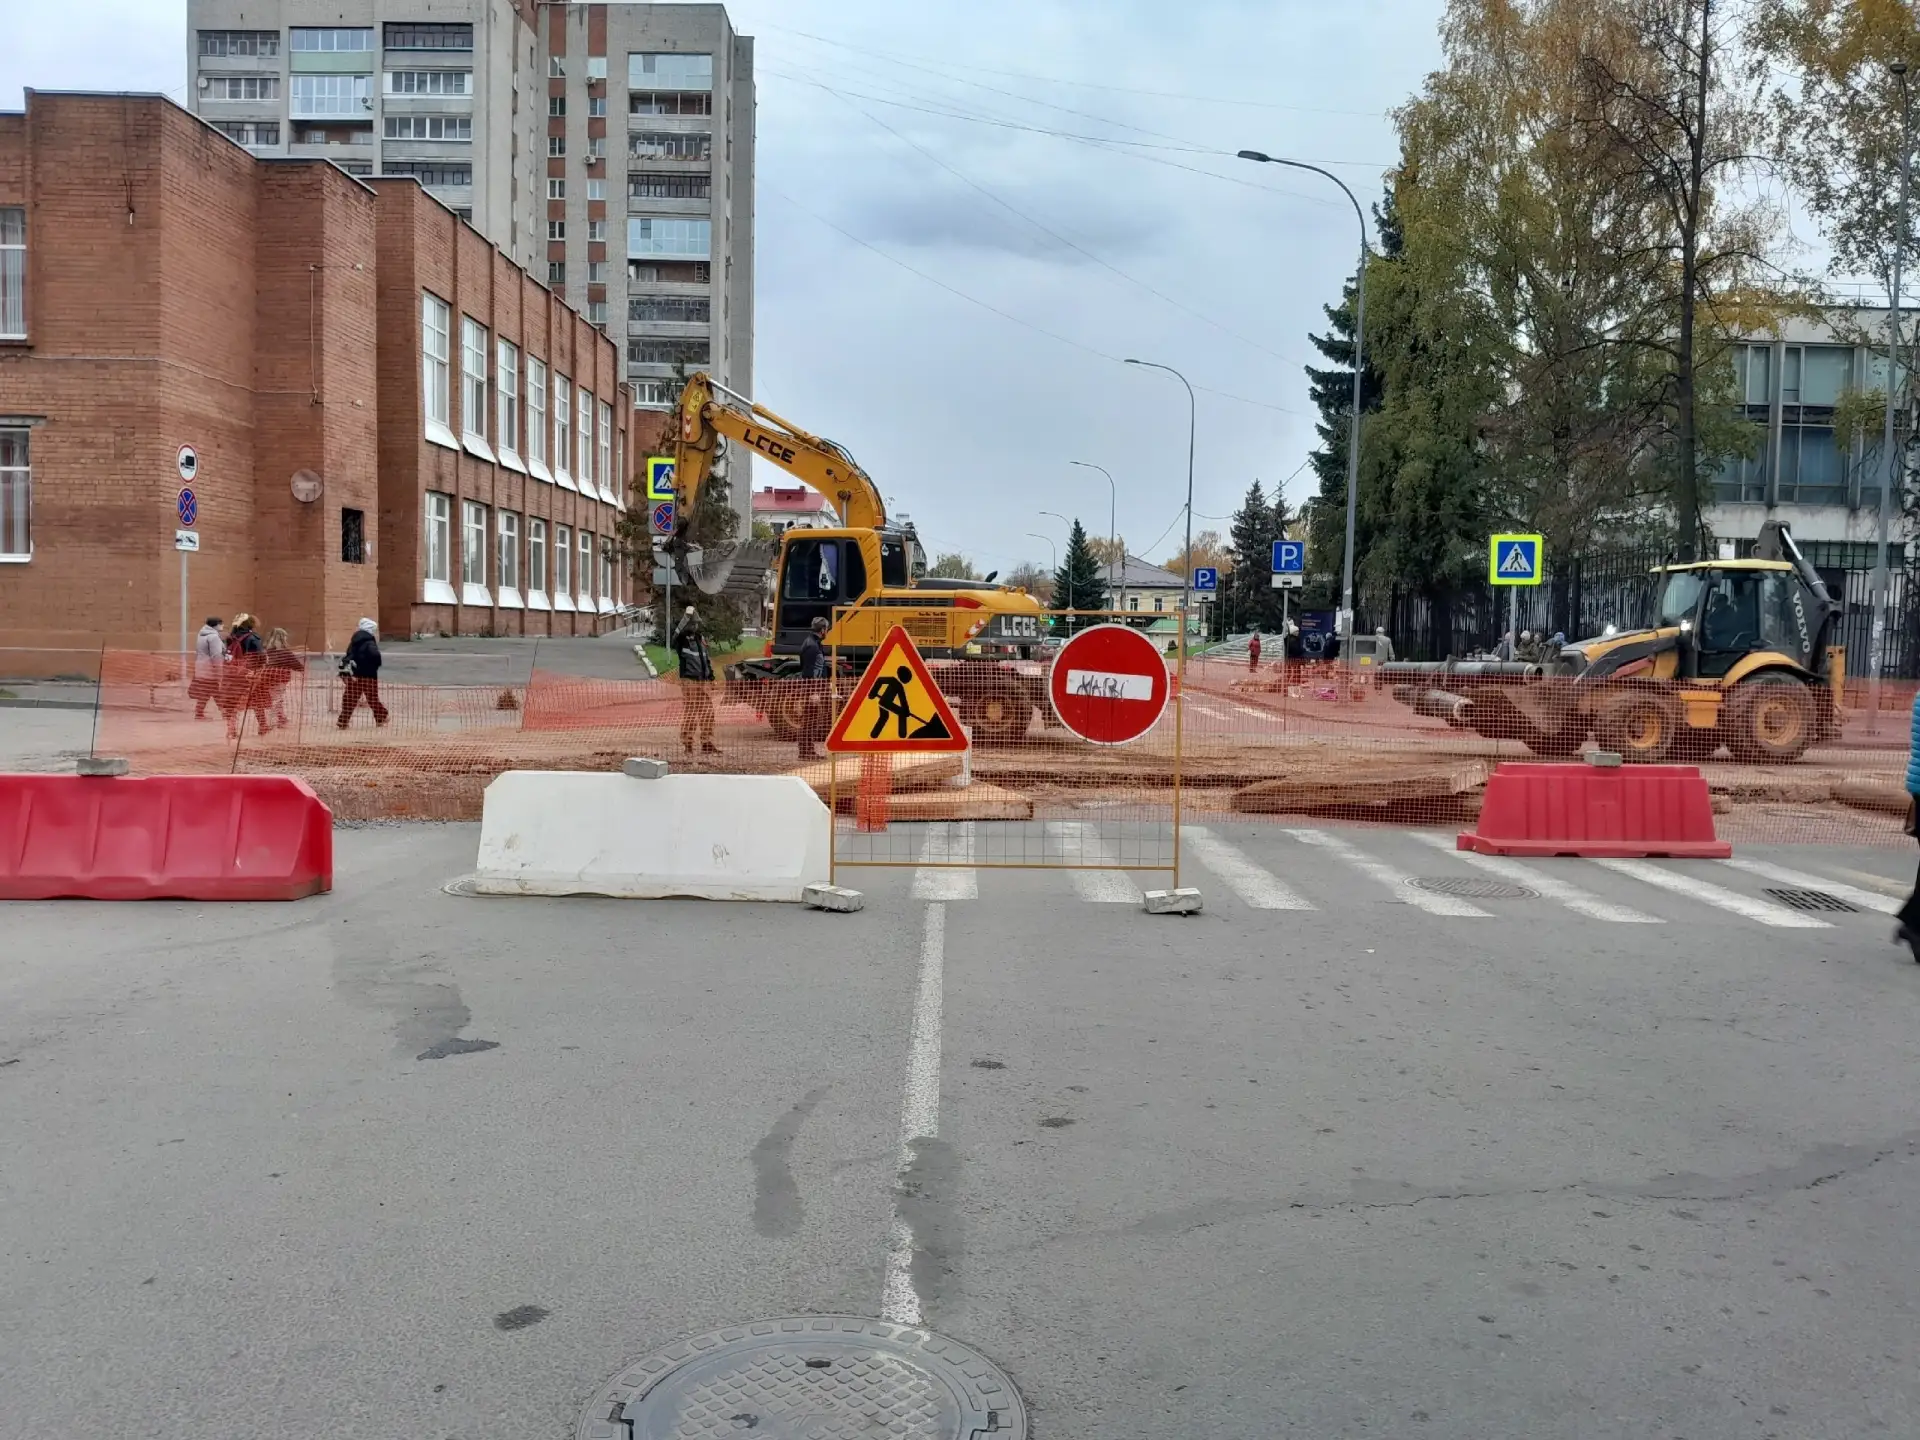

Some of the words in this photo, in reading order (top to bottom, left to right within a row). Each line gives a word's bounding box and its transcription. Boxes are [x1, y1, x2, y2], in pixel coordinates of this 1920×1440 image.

[1281, 545, 1298, 569] P
[1198, 570, 1210, 587] P
[1793, 590, 1811, 653] VOLVO
